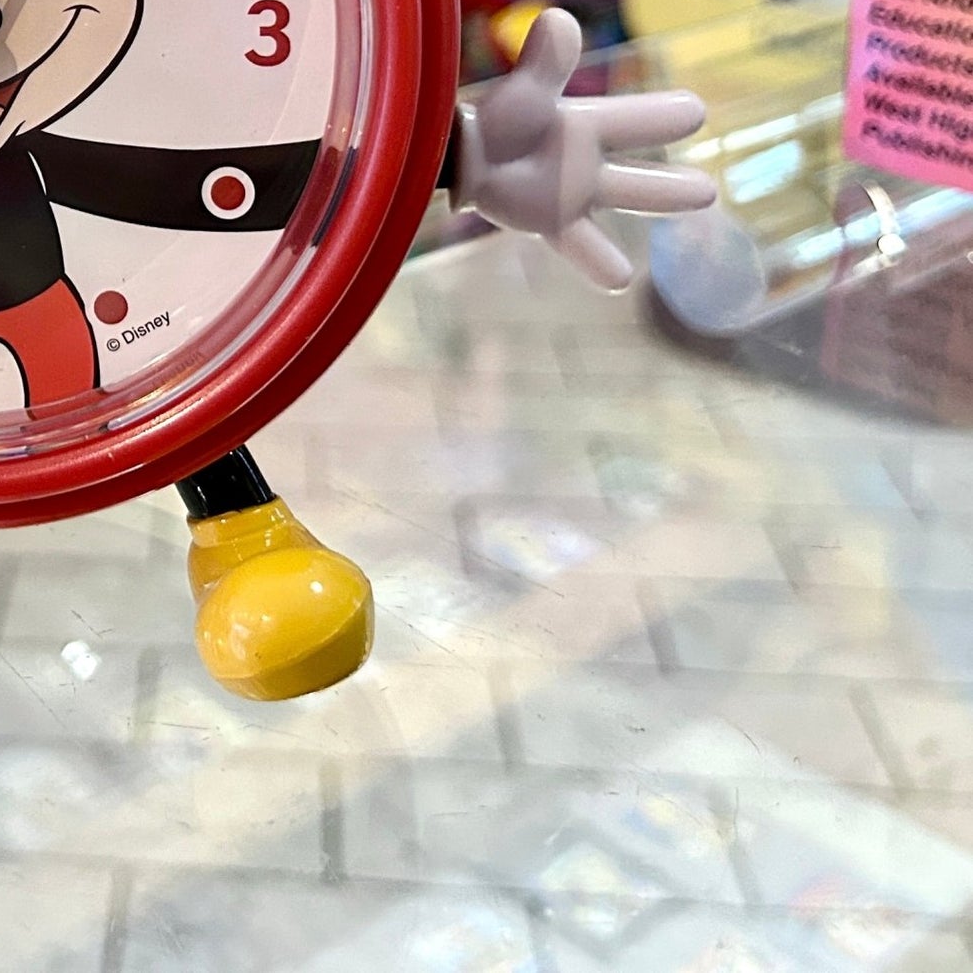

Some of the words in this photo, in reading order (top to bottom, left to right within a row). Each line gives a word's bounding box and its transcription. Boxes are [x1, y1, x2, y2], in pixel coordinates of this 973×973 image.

[244, 0, 291, 67] 3
[864, 92, 922, 124] West
[121, 311, 171, 345] Disney
